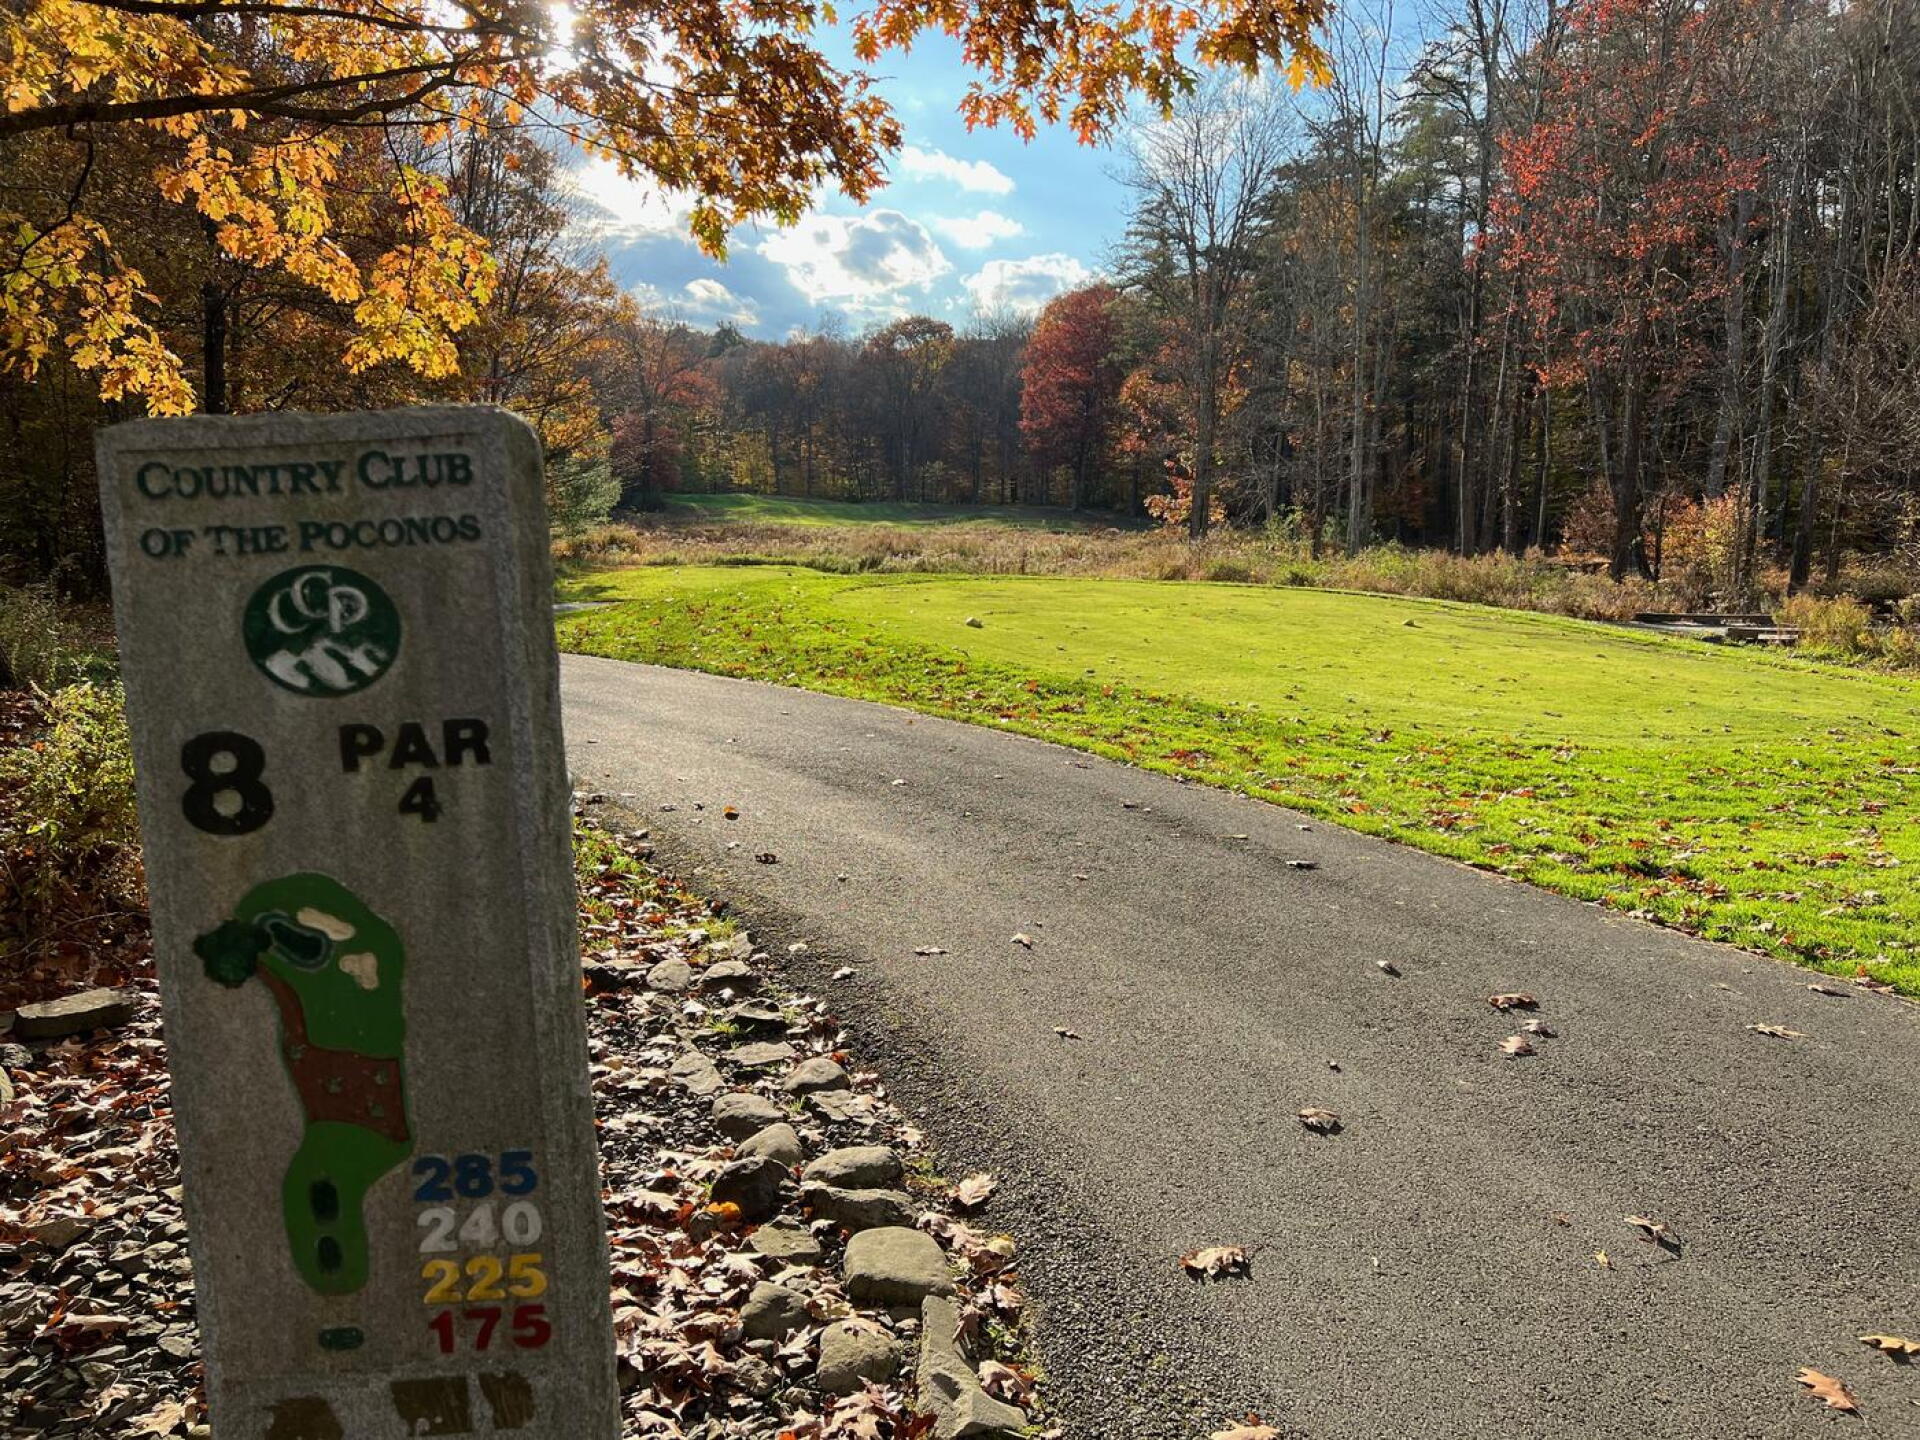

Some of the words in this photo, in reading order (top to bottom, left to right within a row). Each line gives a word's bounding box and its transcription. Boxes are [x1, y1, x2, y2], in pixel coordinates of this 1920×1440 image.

[137, 460, 345, 500] COUNTRY
[357, 451, 473, 489] CLUB
[140, 528, 195, 559] OF
[205, 524, 288, 555] THE
[300, 514, 482, 552] POCONOS
[339, 718, 491, 772] PAR
[181, 731, 274, 836] 8
[399, 777, 440, 823] 4
[412, 1151, 538, 1201] 285
[417, 1201, 542, 1253] 240
[422, 1253, 548, 1304] 225
[430, 1304, 551, 1353] 175
